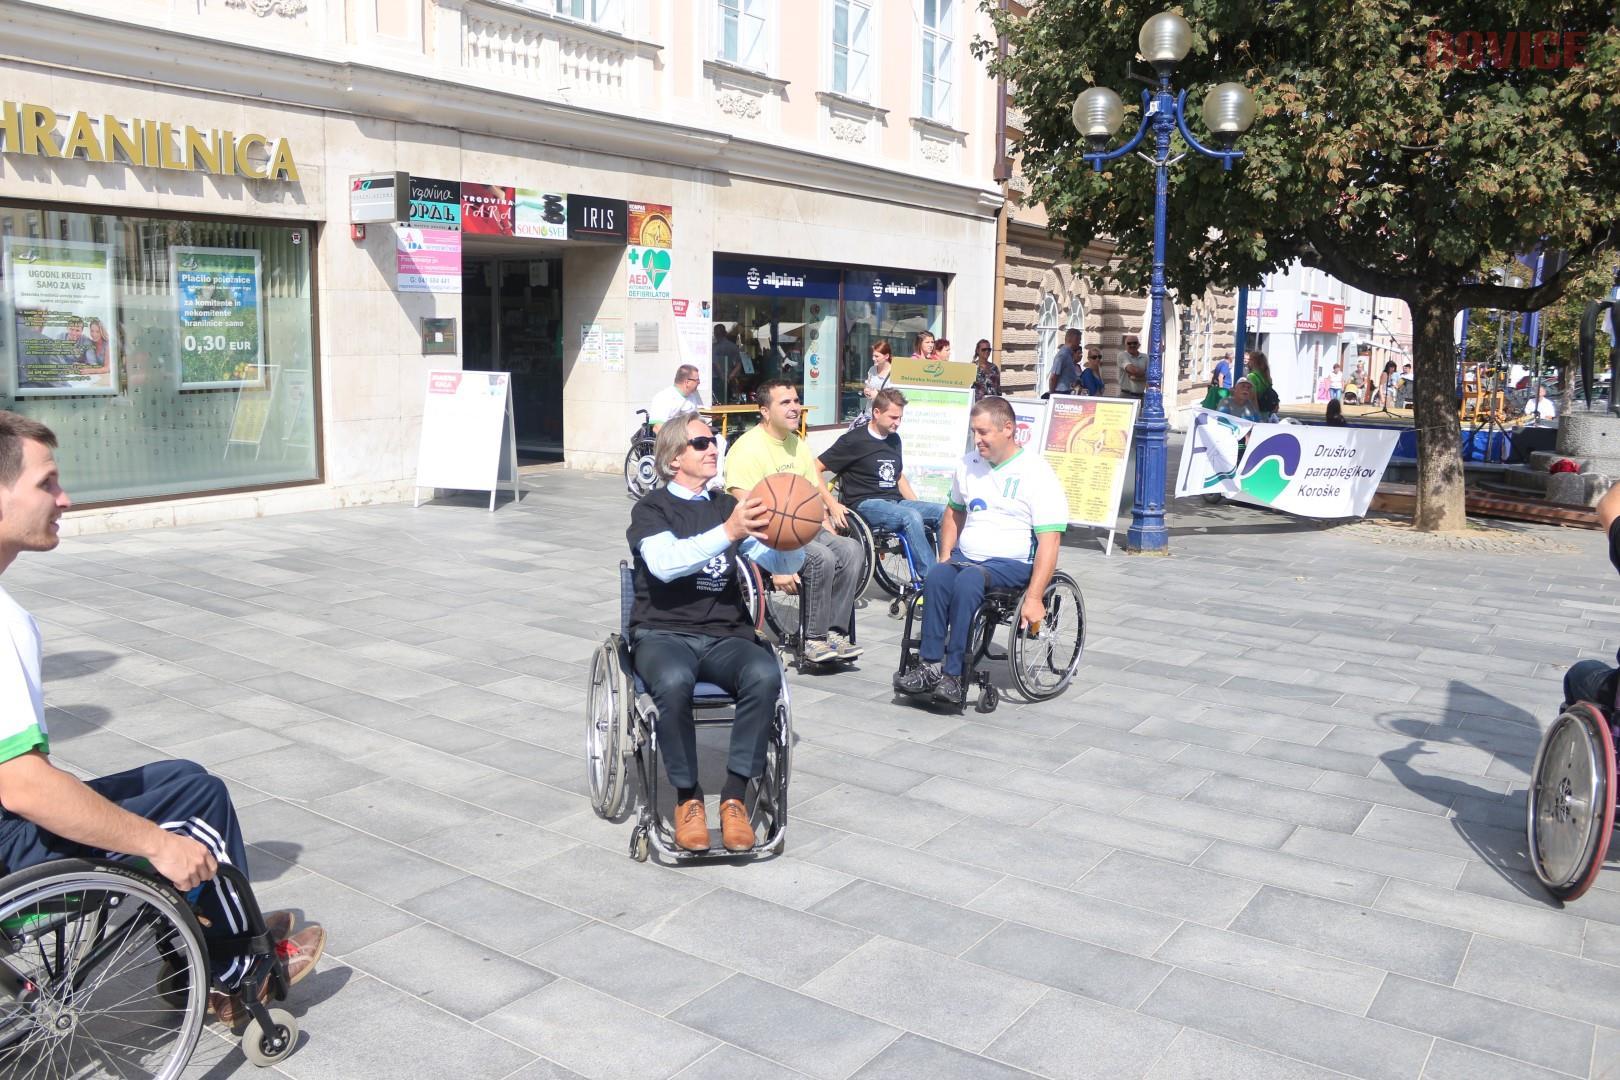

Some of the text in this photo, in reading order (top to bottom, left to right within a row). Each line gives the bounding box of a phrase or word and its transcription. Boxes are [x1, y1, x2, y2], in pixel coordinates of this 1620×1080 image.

[463, 195, 514, 206] TRGOVINA
[463, 203, 512, 223] TARA
[583, 207, 614, 230] IRIS
[517, 224, 541, 235] SOLNI
[28, 270, 92, 280] UGODNI KREDITI
[182, 274, 211, 283] Plačilo
[629, 274, 648, 285] AED
[762, 271, 804, 289] alpina
[36, 281, 58, 289] SAMO
[72, 282, 86, 290] VAS
[884, 283, 916, 297] alpina
[628, 290, 670, 298] DEFIBRILATOR
[195, 299, 233, 307] komitente
[184, 309, 232, 317] nekomitente
[184, 319, 223, 328] hranilnice
[1297, 321, 1318, 329] MANA
[184, 335, 252, 354] 0,30 EUR
[1054, 402, 1083, 413] KOMPAS
[1314, 444, 1356, 458] Društvo
[1304, 465, 1376, 479] paraplegikov
[1003, 477, 1021, 499] 11
[1297, 483, 1341, 497] Koroške
